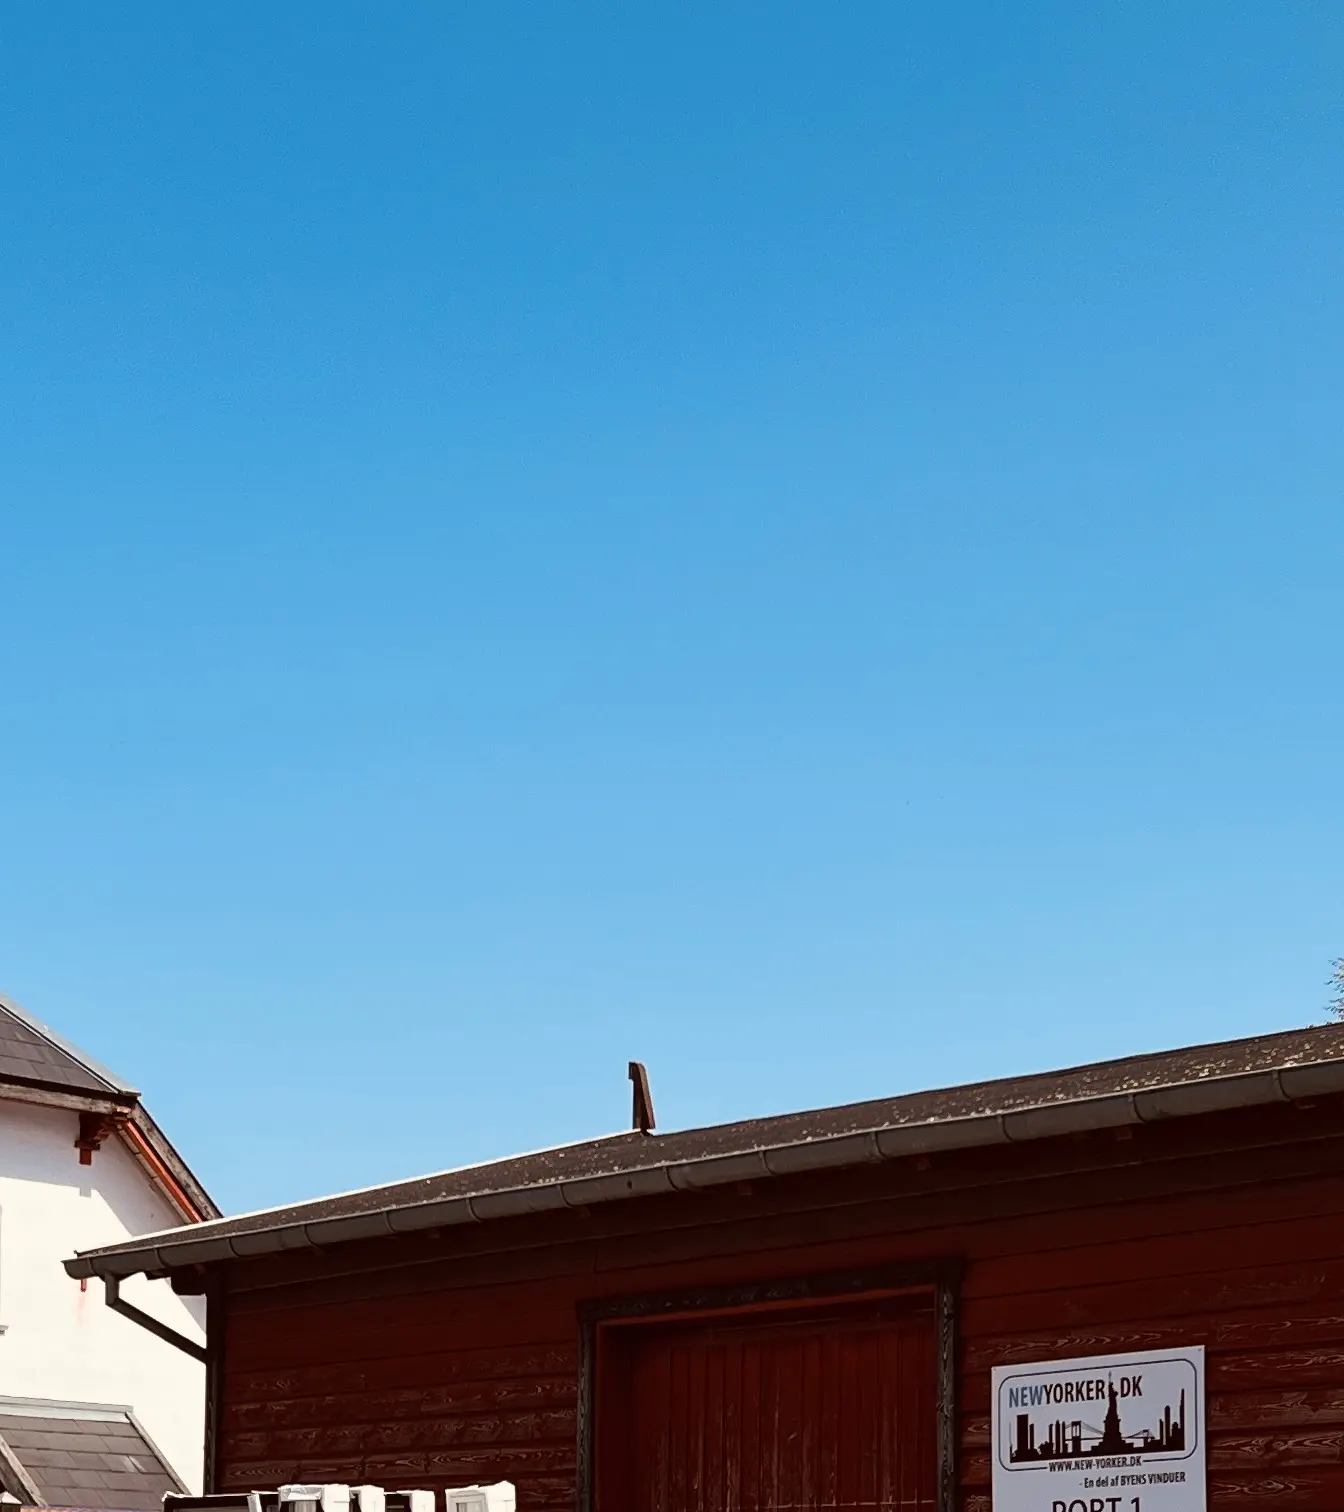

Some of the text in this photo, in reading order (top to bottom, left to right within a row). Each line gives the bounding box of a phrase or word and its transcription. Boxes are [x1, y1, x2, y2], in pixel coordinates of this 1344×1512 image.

[1049, 1456, 1142, 1472] WWW.NEW-YORKER.DK
[1084, 1477, 1094, 1488] En
[1096, 1476, 1108, 1487] del
[1110, 1475, 1119, 1486] af
[1120, 1474, 1146, 1486] BYENS
[1147, 1472, 1185, 1484] VINDUER
